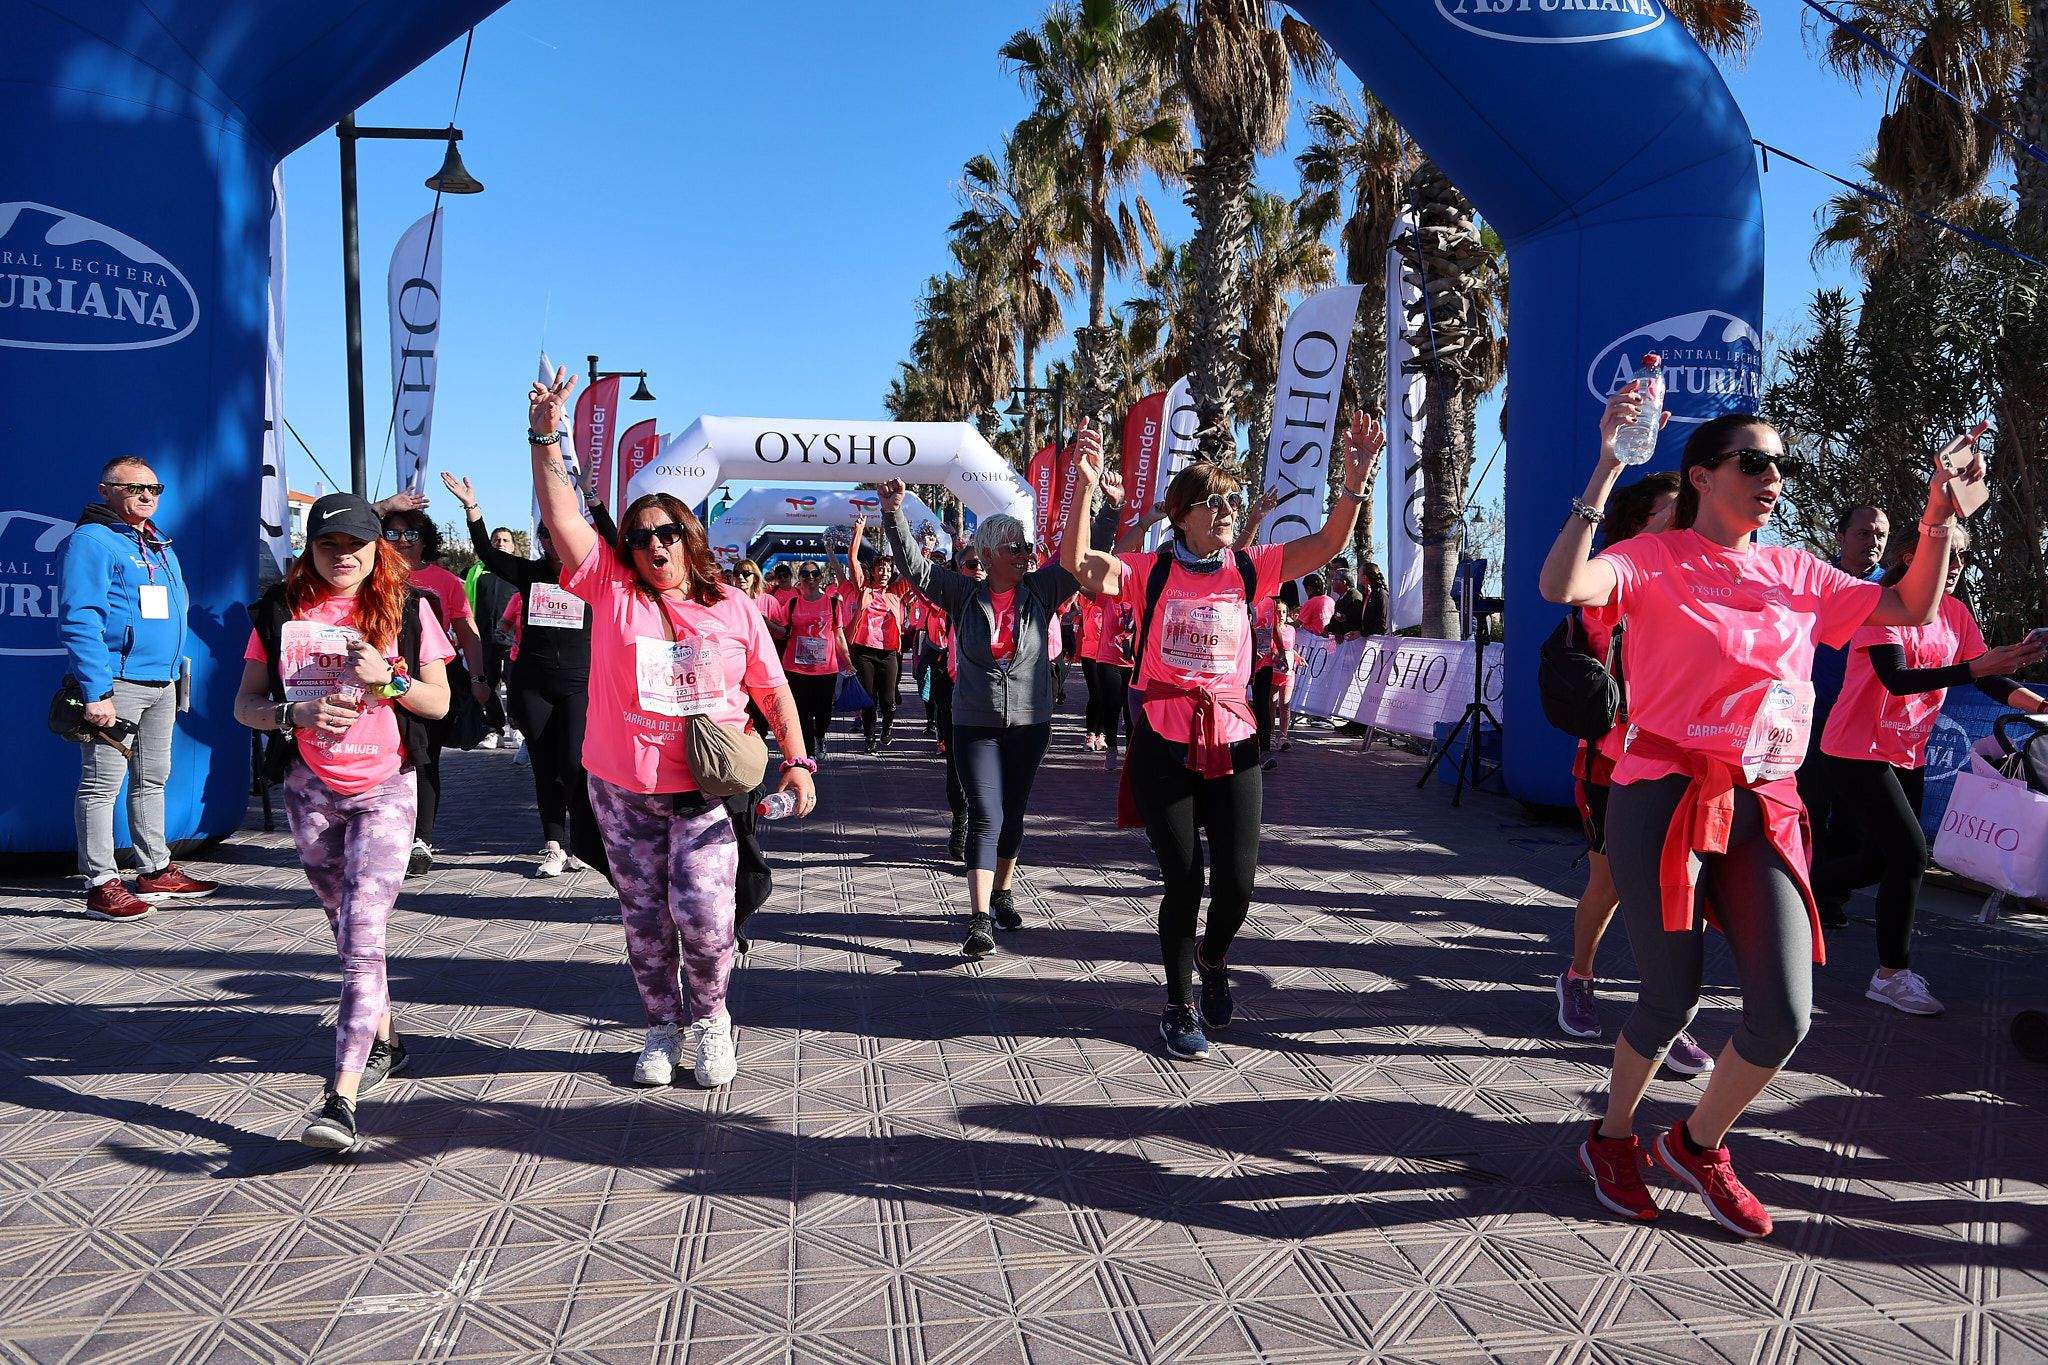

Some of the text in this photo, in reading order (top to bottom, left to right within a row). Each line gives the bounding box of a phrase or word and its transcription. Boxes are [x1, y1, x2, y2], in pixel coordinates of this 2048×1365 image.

[55, 257, 168, 287] LECHERA
[755, 431, 917, 467] OYSHO
[1131, 417, 1157, 509] Santander
[655, 465, 706, 478] OYSHO
[961, 471, 1009, 482] OYSHO
[1037, 465, 1051, 533] Santander
[780, 539, 845, 547] VOLO
[1165, 588, 1198, 598] OYSHO
[548, 601, 568, 610] 016
[1190, 633, 1219, 646] 016
[1357, 647, 1448, 694] OYSHO
[665, 671, 697, 687] 016
[295, 689, 328, 697] OYSHO
[623, 710, 684, 732] CARRERA DE LA
[345, 743, 379, 755] MUJER
[1943, 809, 2020, 852] OYSHO
